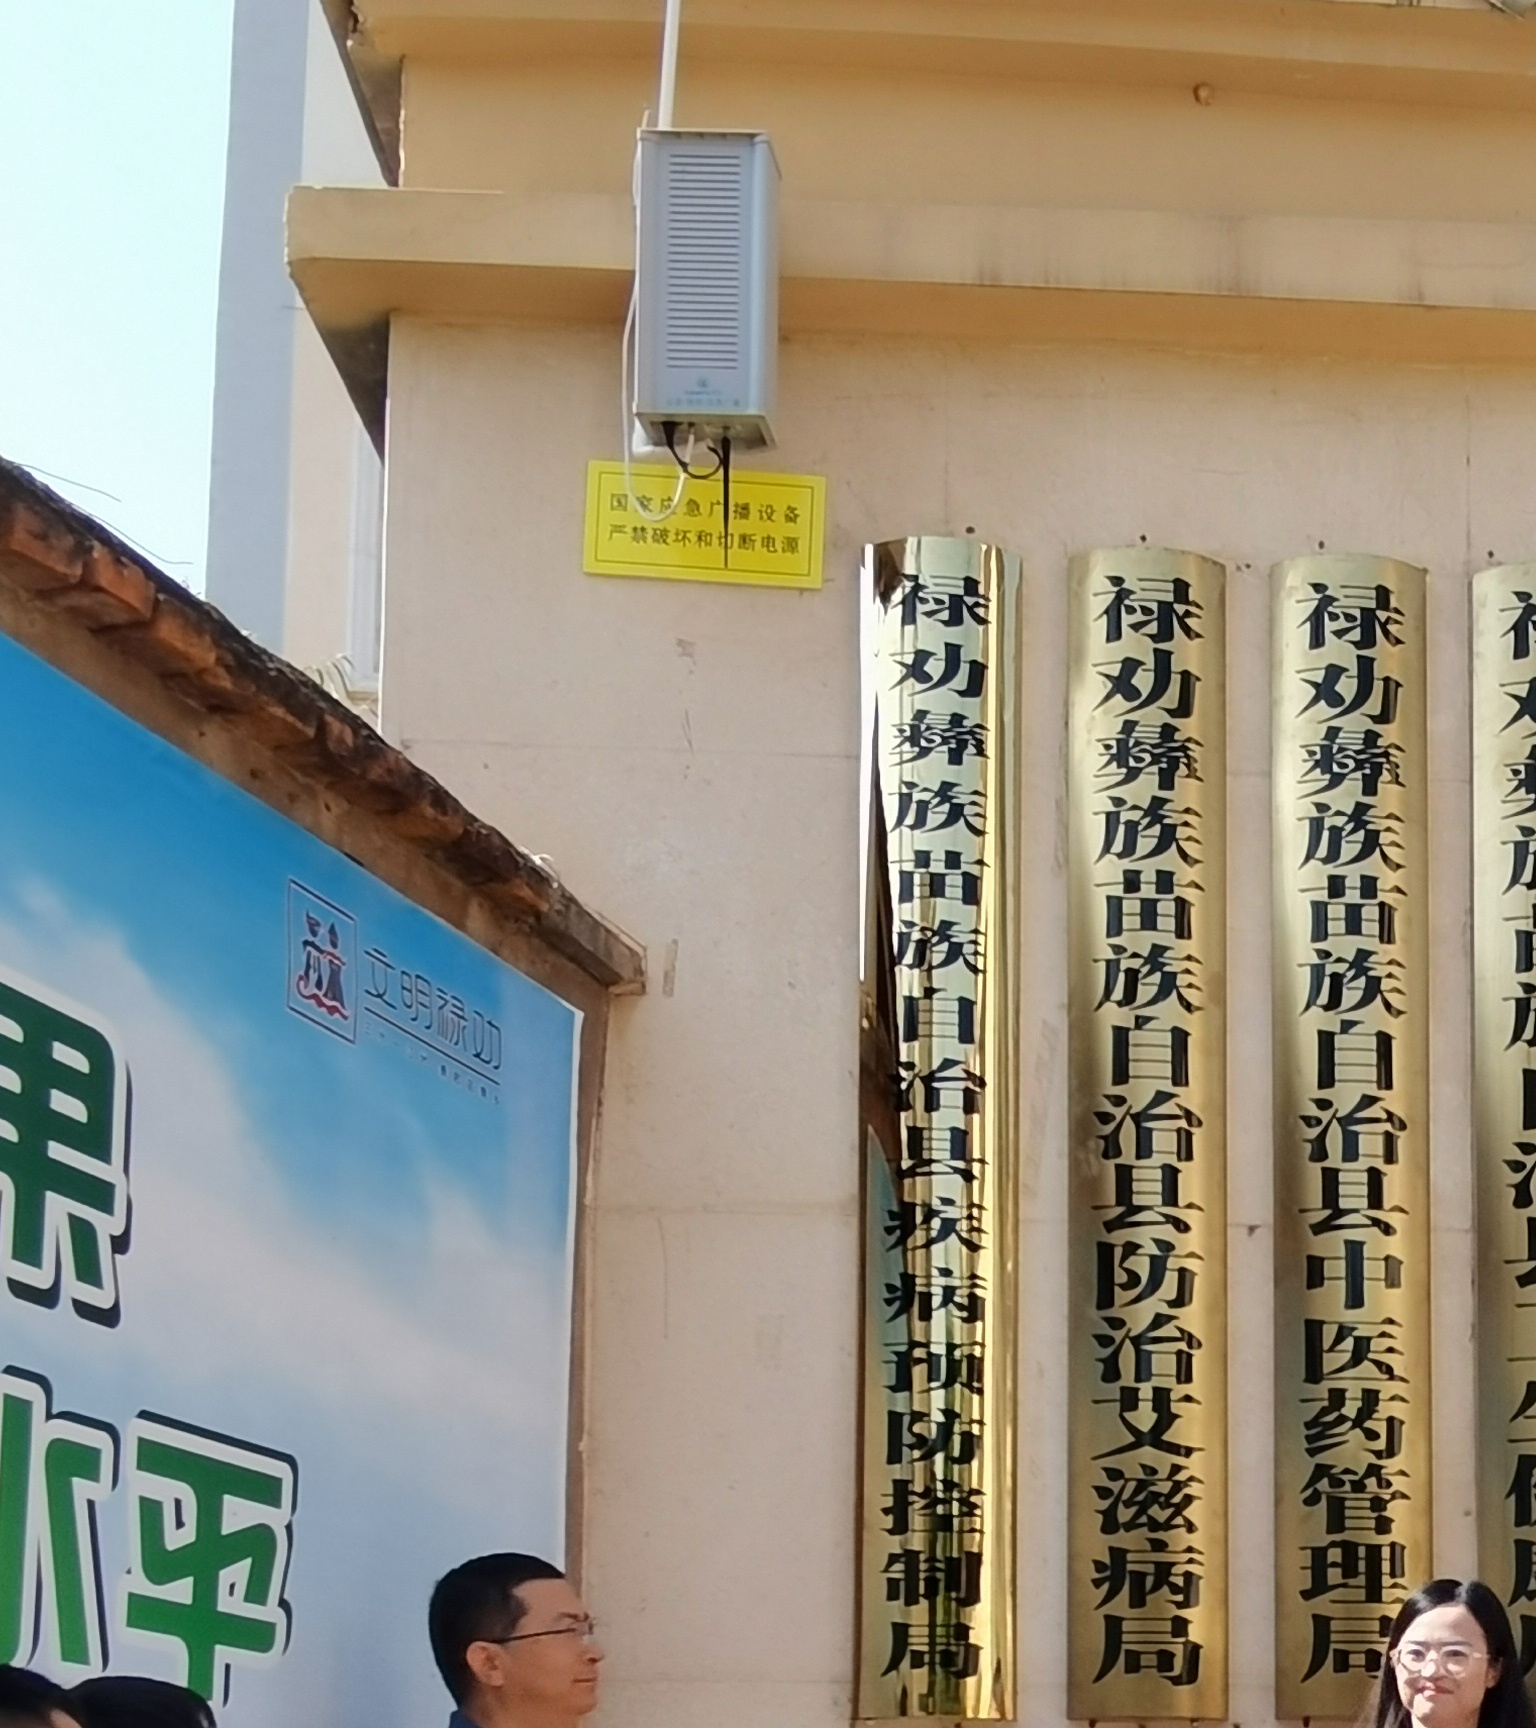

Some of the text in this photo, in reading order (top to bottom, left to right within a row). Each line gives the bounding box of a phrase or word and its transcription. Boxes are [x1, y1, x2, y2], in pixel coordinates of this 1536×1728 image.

[608, 524, 801, 555] 严禁破坏和切断电源
[609, 493, 801, 525] 国家应急广播设备
[364, 947, 502, 1071] 文明禄劝
[880, 573, 992, 1684] 禄劝彝族苗族自治县疾病预防控制局
[1090, 575, 1206, 1686] 禄劝彝族苗族自治县防治艾滋病局
[1295, 582, 1411, 1684] 禄劝彝族苗族自治县中医药管理局
